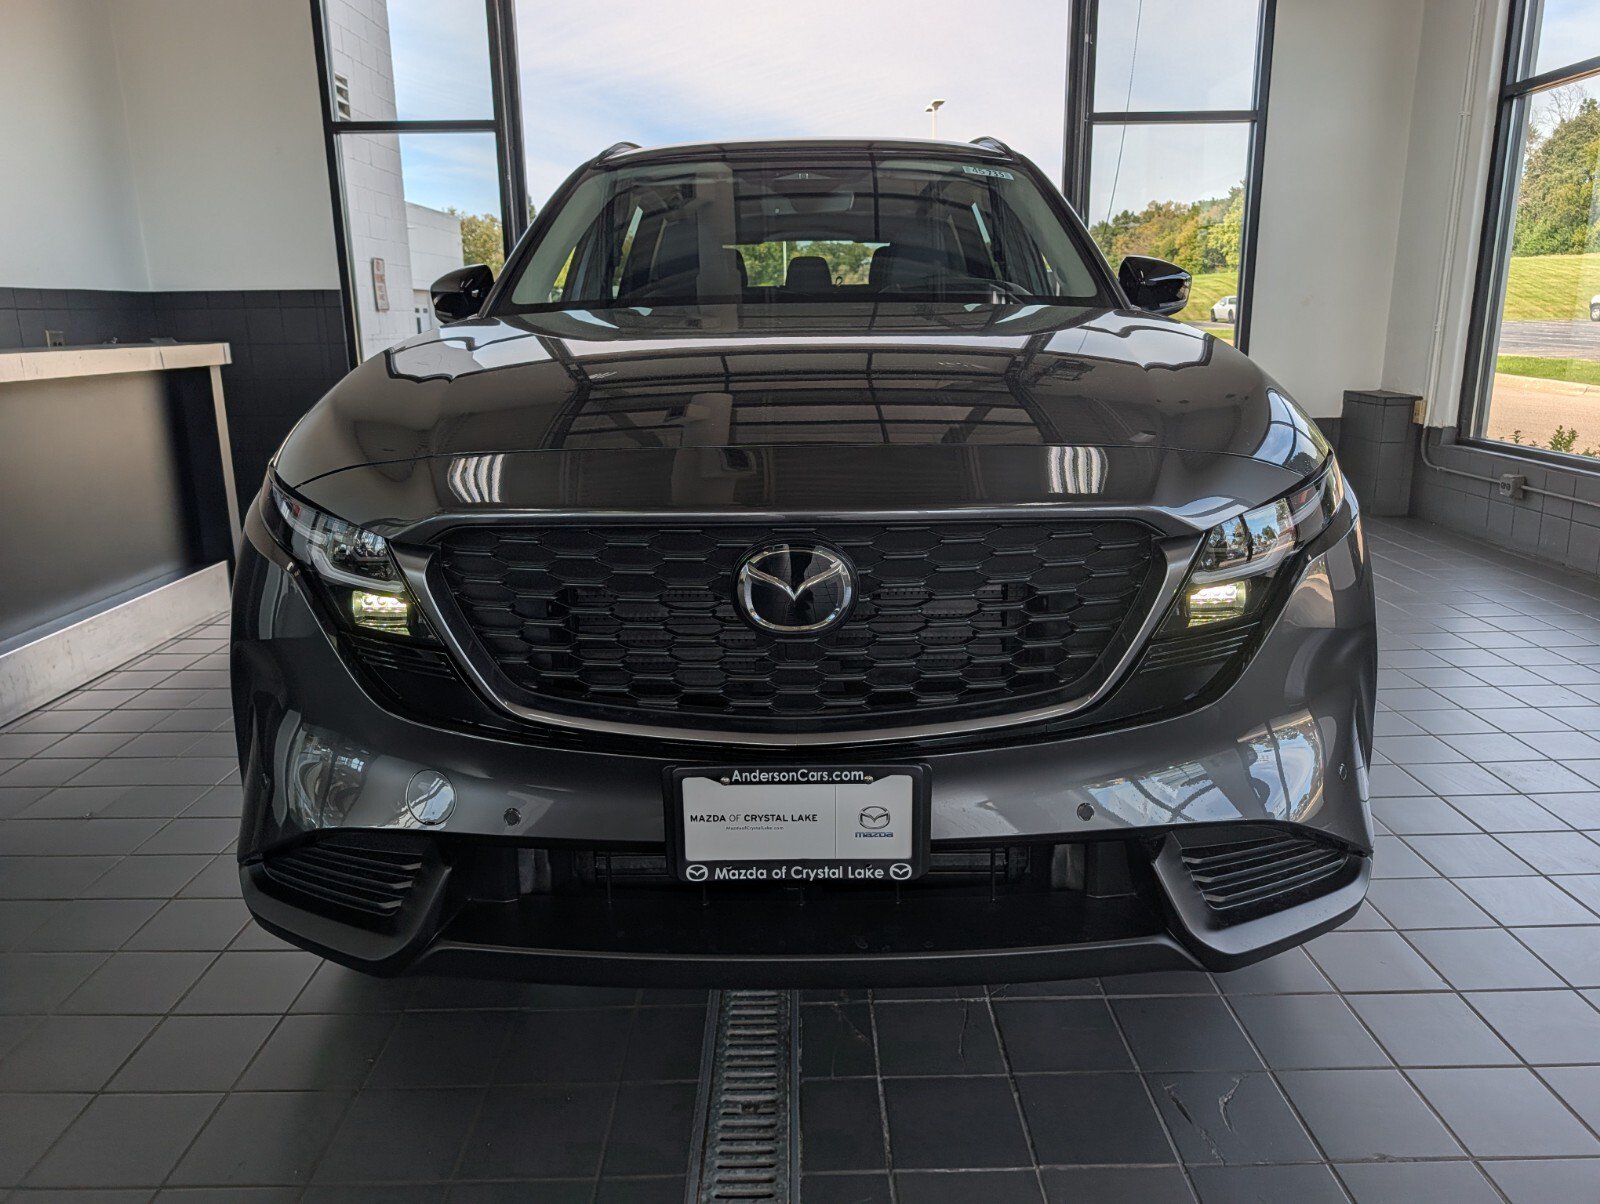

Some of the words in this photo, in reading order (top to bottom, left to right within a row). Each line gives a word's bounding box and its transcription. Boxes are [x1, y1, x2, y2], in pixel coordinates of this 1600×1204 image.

[732, 769, 864, 781] AndersonCars.com
[690, 814, 726, 823] MAZDA
[729, 813, 741, 822] OF
[744, 813, 788, 822] CRYSTAL
[791, 813, 818, 822] LAKE
[715, 866, 767, 880] Mazda
[772, 865, 786, 879] of
[790, 865, 843, 882] Crystal
[848, 865, 884, 879] Lake
